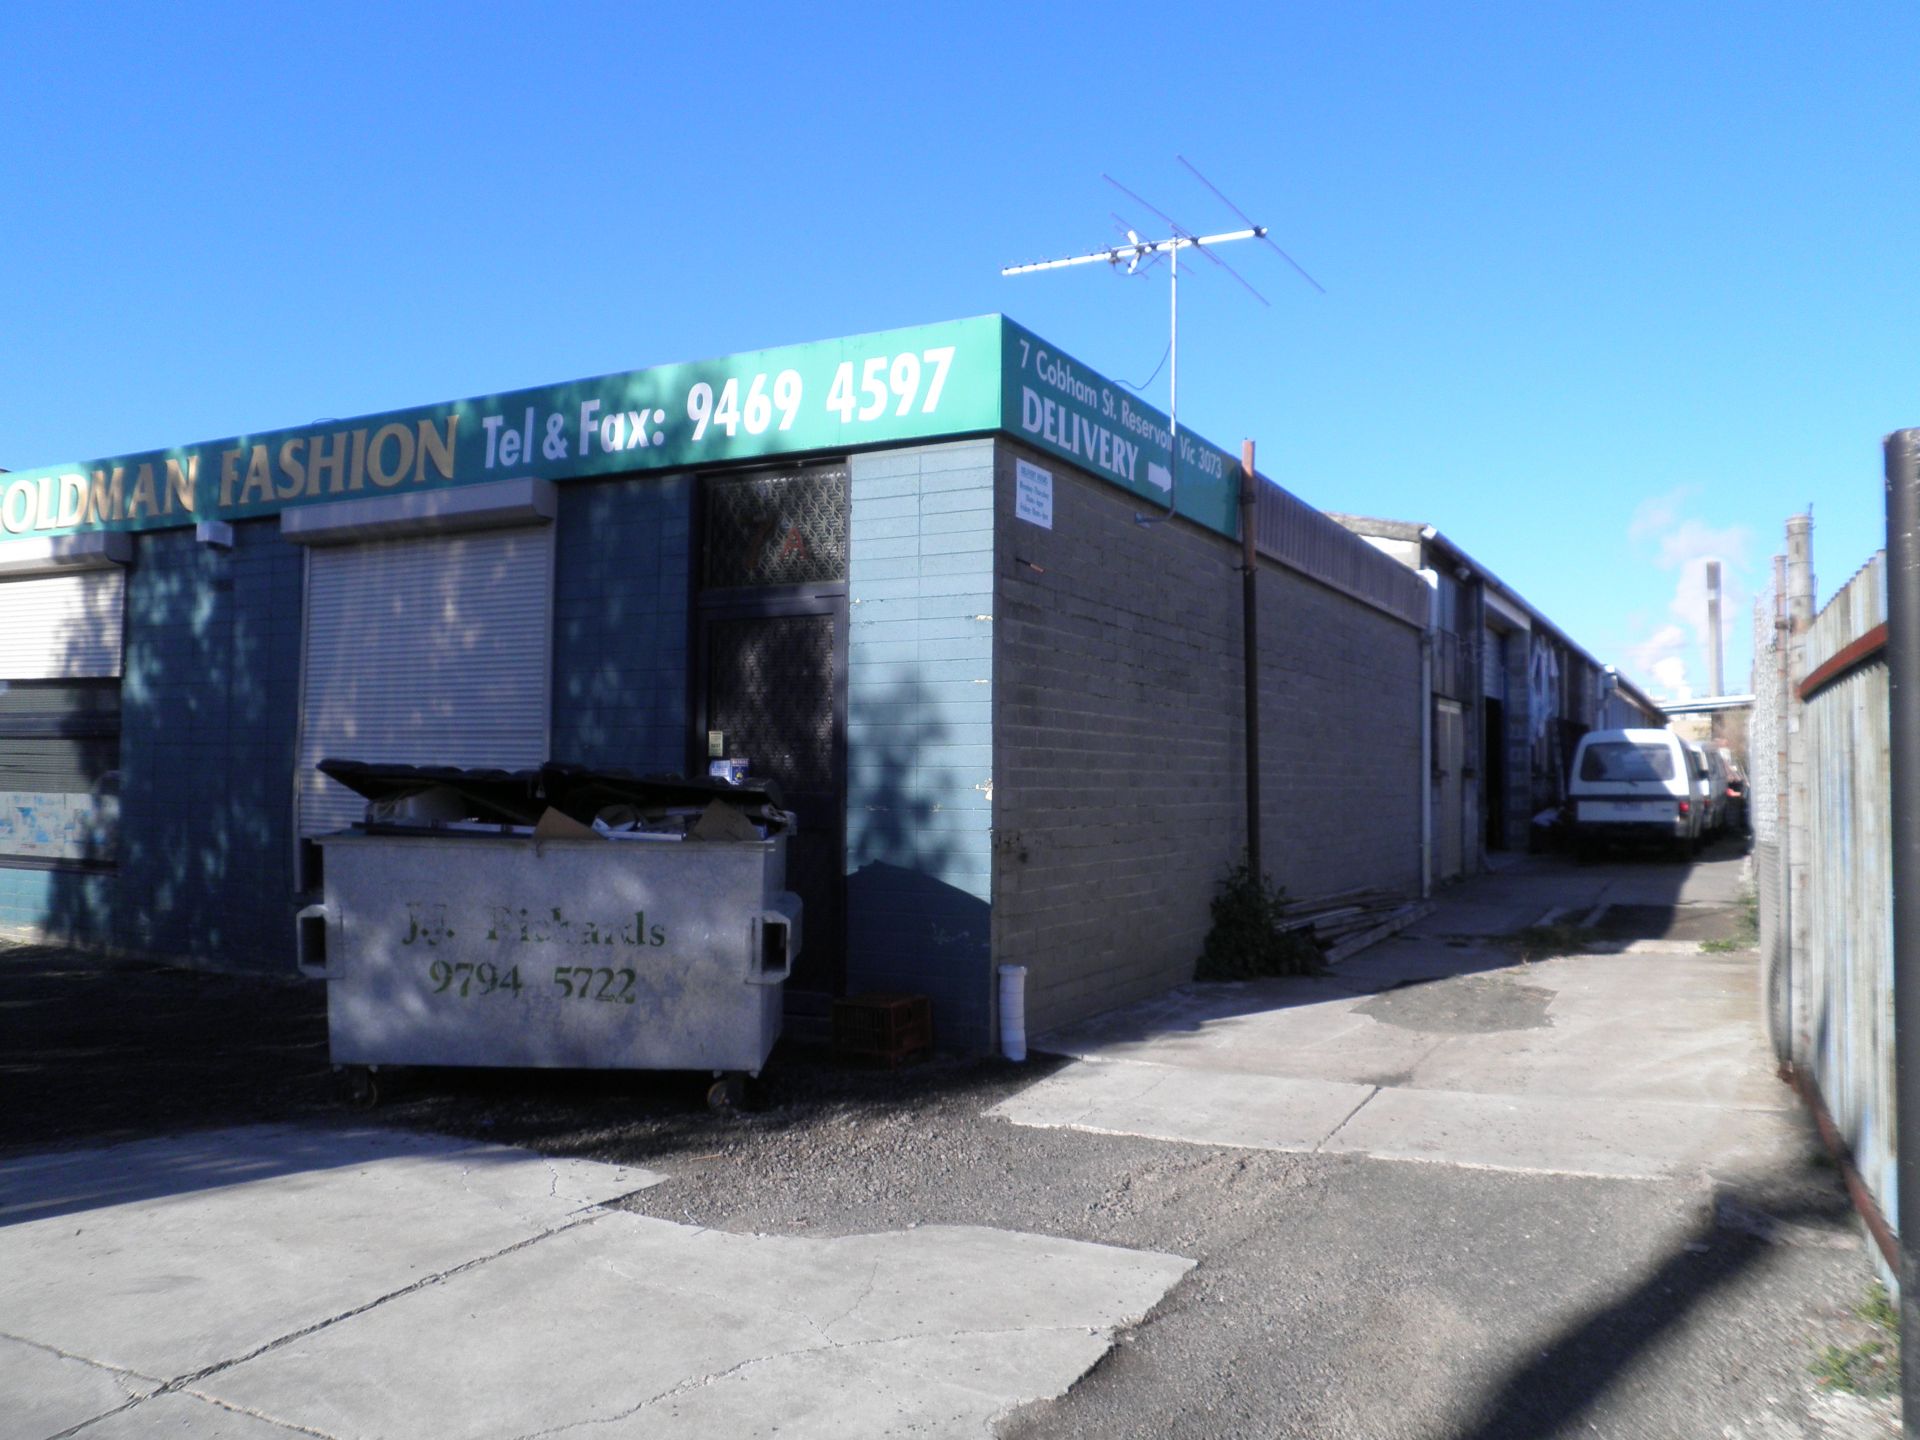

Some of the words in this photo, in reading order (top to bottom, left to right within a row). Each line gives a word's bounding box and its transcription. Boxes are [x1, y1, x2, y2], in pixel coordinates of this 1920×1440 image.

[483, 415, 533, 469] Tel
[542, 412, 568, 461] &
[579, 399, 665, 457] Fax:
[686, 368, 802, 442] 9469
[826, 346, 956, 423] 4597
[1020, 339, 1030, 368] 7
[1036, 350, 1098, 409] Cobham
[1102, 388, 1117, 421] St.
[1180, 434, 1195, 464] Vic
[1198, 447, 1222, 479] 3073
[1022, 385, 1139, 481] DELIVERY
[0, 455, 196, 534] OLDMAN
[219, 414, 459, 508] FASHION
[429, 960, 522, 998] 9794
[553, 966, 636, 1004] 5722
